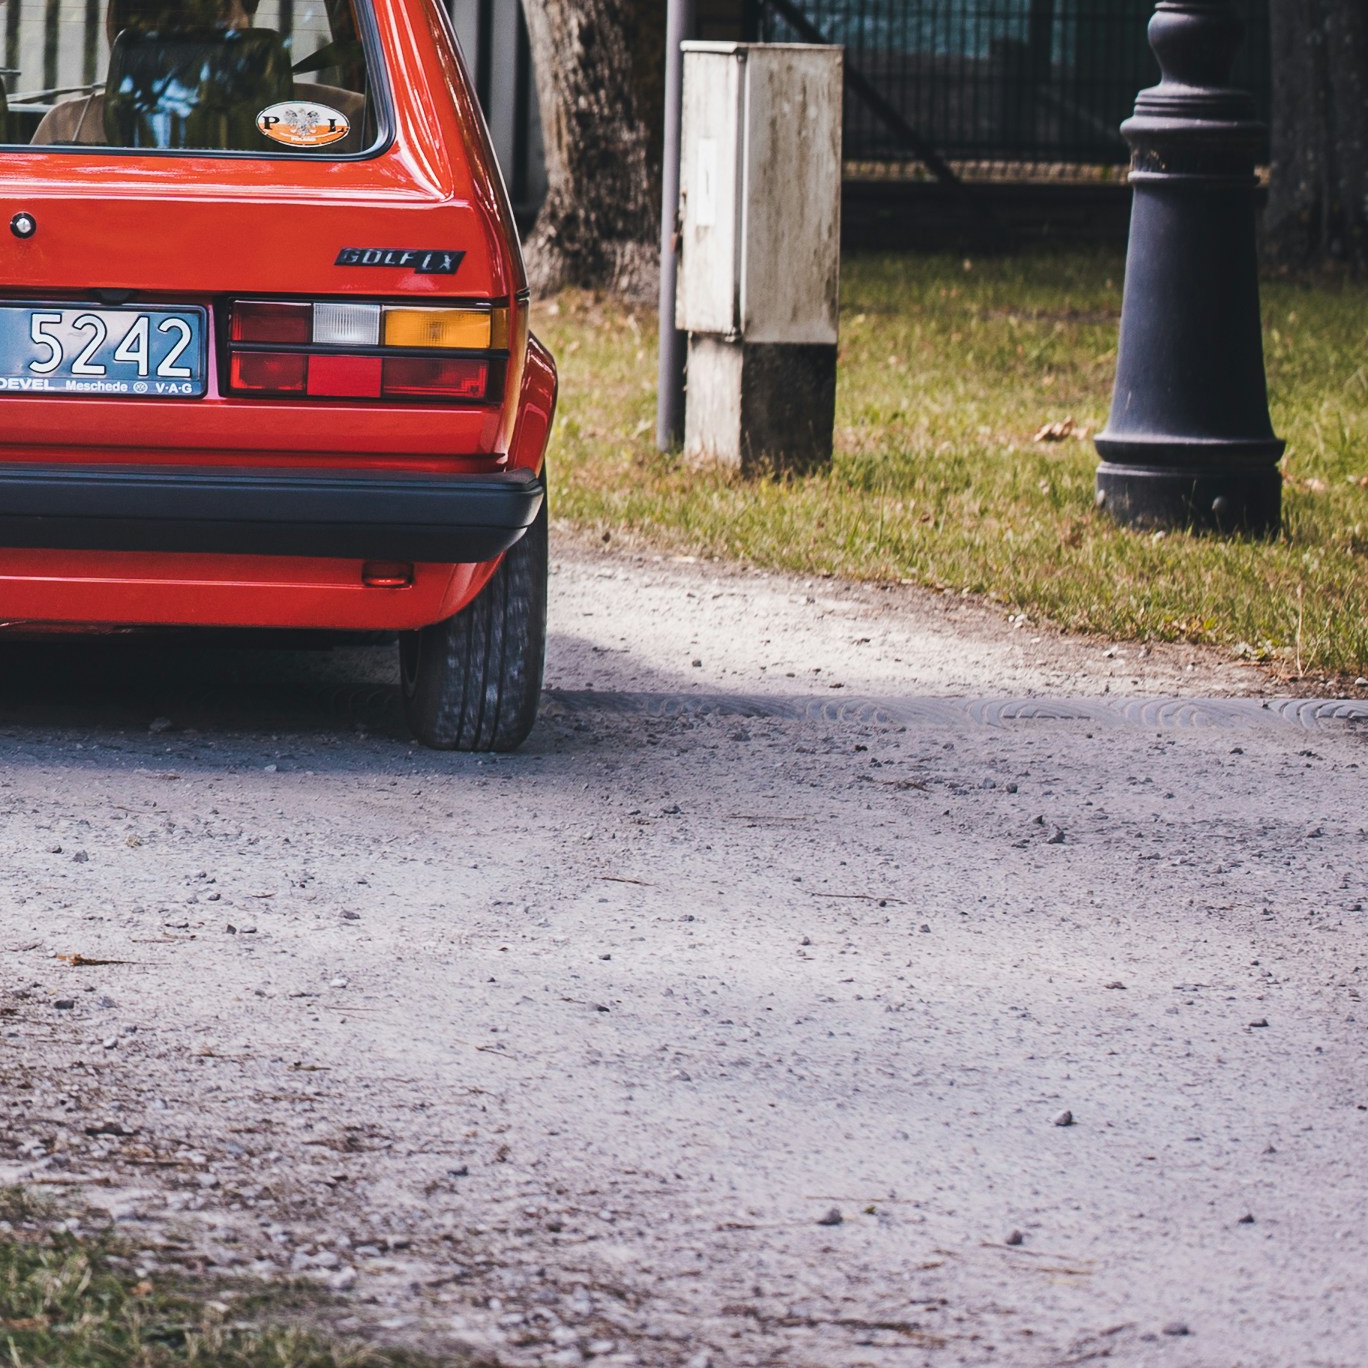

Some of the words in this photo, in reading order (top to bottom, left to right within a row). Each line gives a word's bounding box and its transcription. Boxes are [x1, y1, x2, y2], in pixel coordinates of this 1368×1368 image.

[343, 248, 415, 265] GOLF
[28, 312, 193, 378] 5242
[65, 380, 128, 392] Meschede
